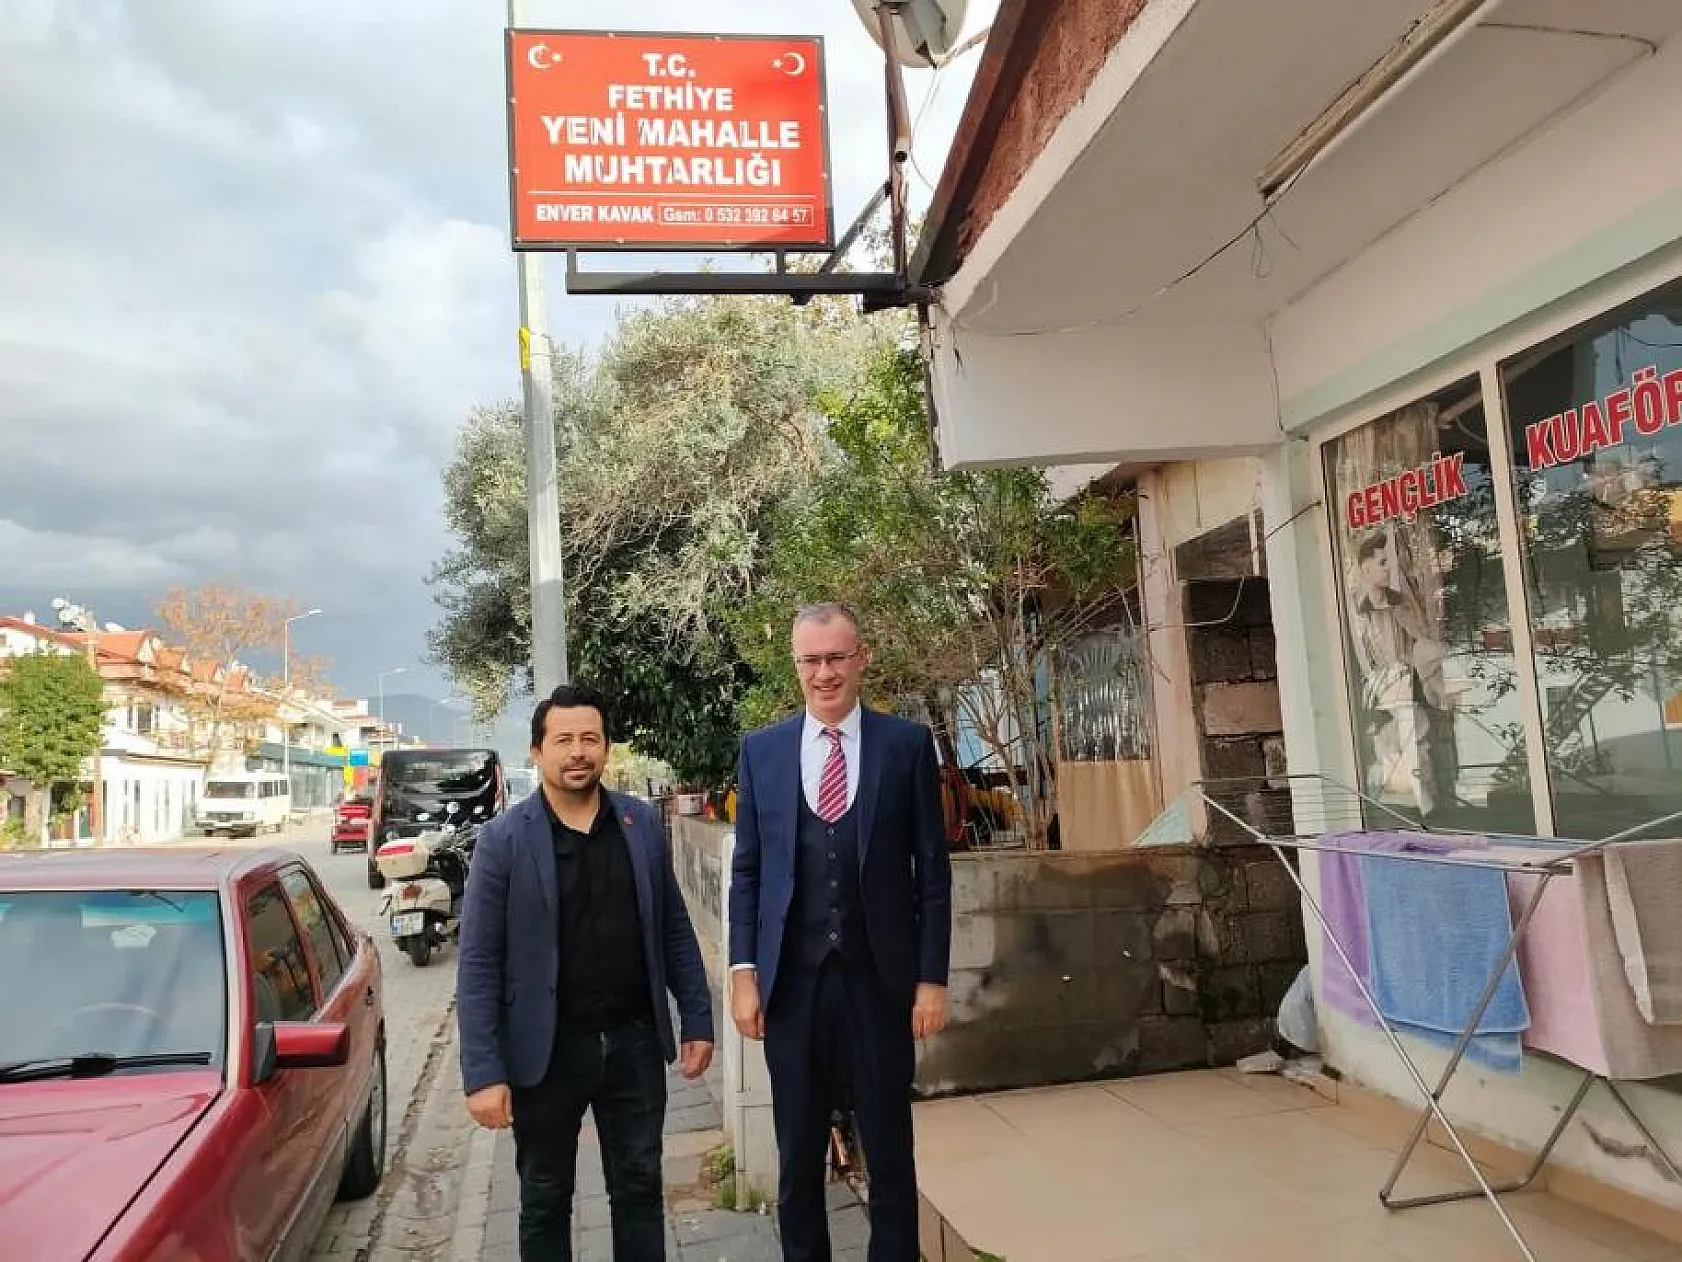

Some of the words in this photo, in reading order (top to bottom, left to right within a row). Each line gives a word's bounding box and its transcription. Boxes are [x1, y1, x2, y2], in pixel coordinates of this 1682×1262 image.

[642, 52, 696, 78] T.C.
[608, 81, 733, 111] FETHİYE
[541, 112, 626, 146] YENİ
[638, 117, 801, 148] MAHALLE
[564, 152, 781, 187] MUHTARLIĞI
[536, 204, 593, 222] ENVER
[597, 205, 654, 223] KAVAK
[704, 207, 714, 222] 0
[1347, 452, 1468, 530] GENÇLİK
